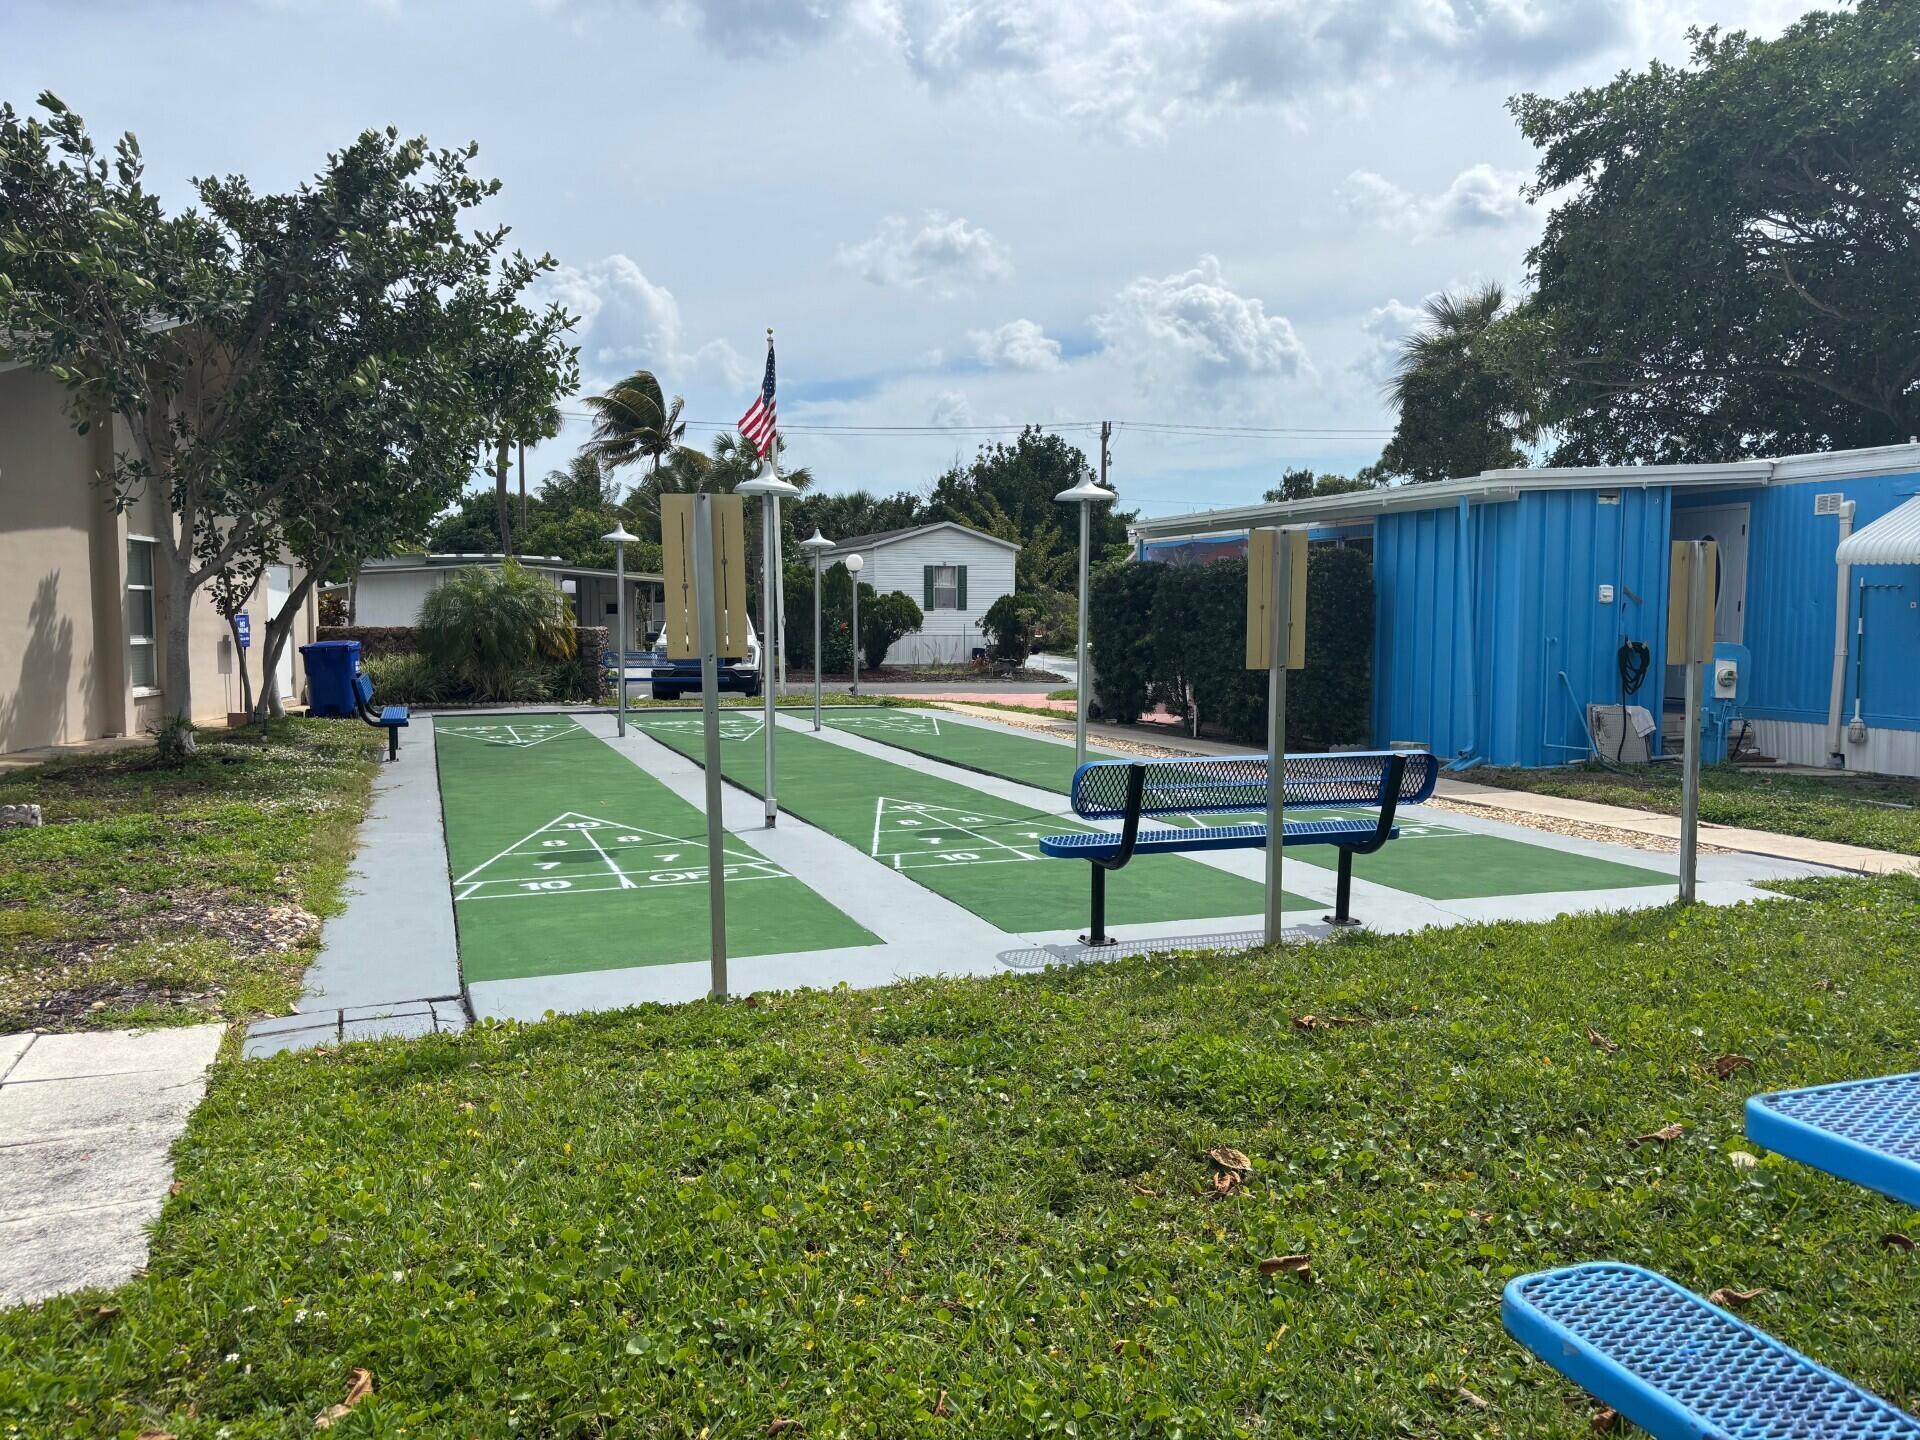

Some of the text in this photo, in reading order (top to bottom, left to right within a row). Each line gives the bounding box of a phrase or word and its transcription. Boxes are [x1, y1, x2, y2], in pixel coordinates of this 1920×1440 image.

[541, 839, 568, 847] 8
[917, 837, 942, 845] 7
[653, 853, 681, 862] 7
[934, 852, 981, 862] 10
[532, 861, 561, 870] 7
[519, 880, 572, 891] 10
